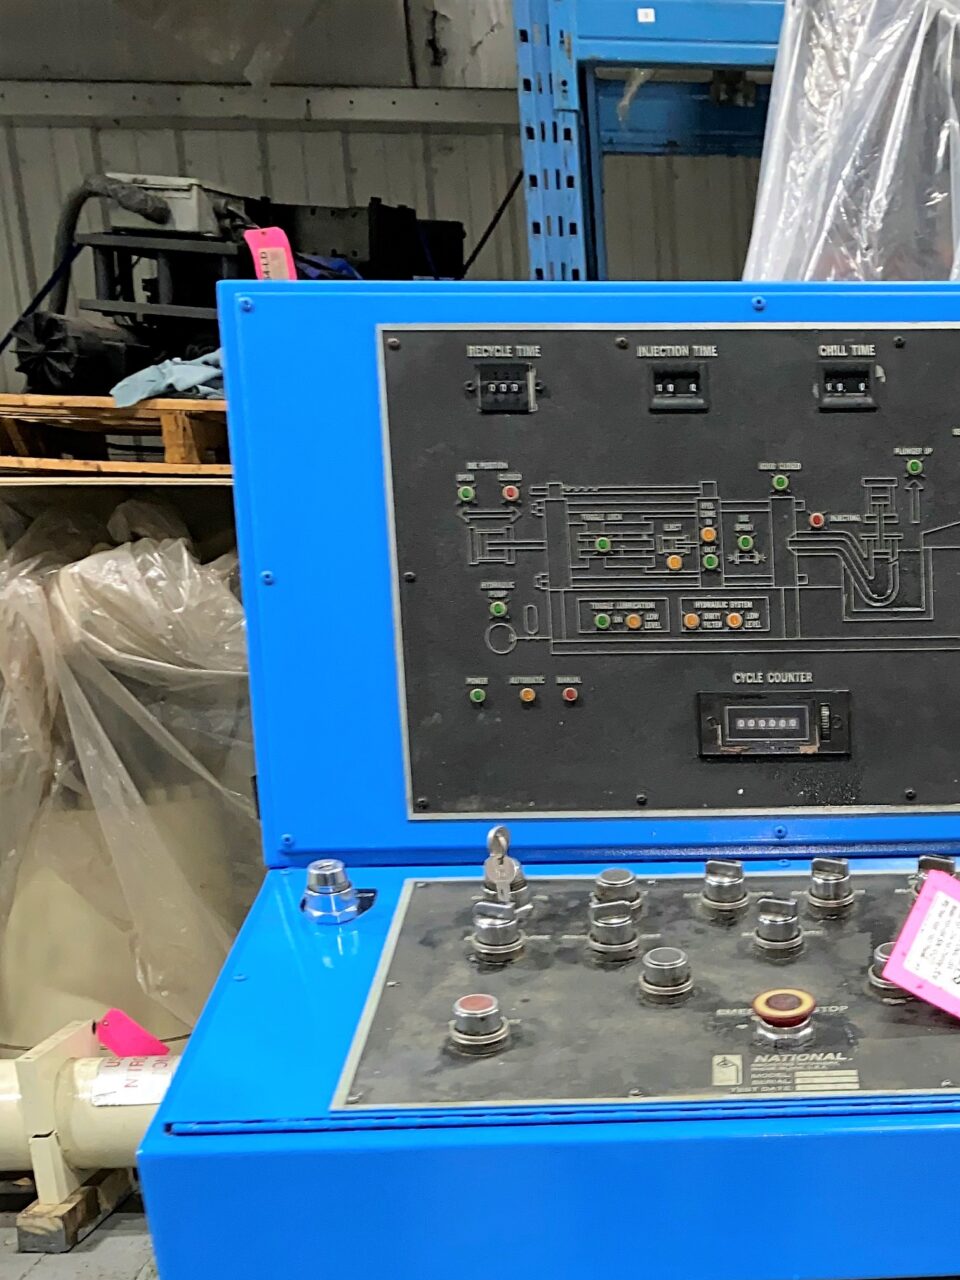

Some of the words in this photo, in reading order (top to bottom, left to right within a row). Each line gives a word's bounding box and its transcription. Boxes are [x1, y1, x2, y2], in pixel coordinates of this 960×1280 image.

[466, 345, 513, 358] RECYCLE
[516, 345, 542, 358] TIME
[637, 345, 690, 358] INJECTION
[693, 345, 719, 358] TIME
[818, 344, 849, 357] CHILL
[850, 344, 876, 357] TIME
[732, 672, 763, 683] CYCLE
[766, 672, 813, 683] COUNTER
